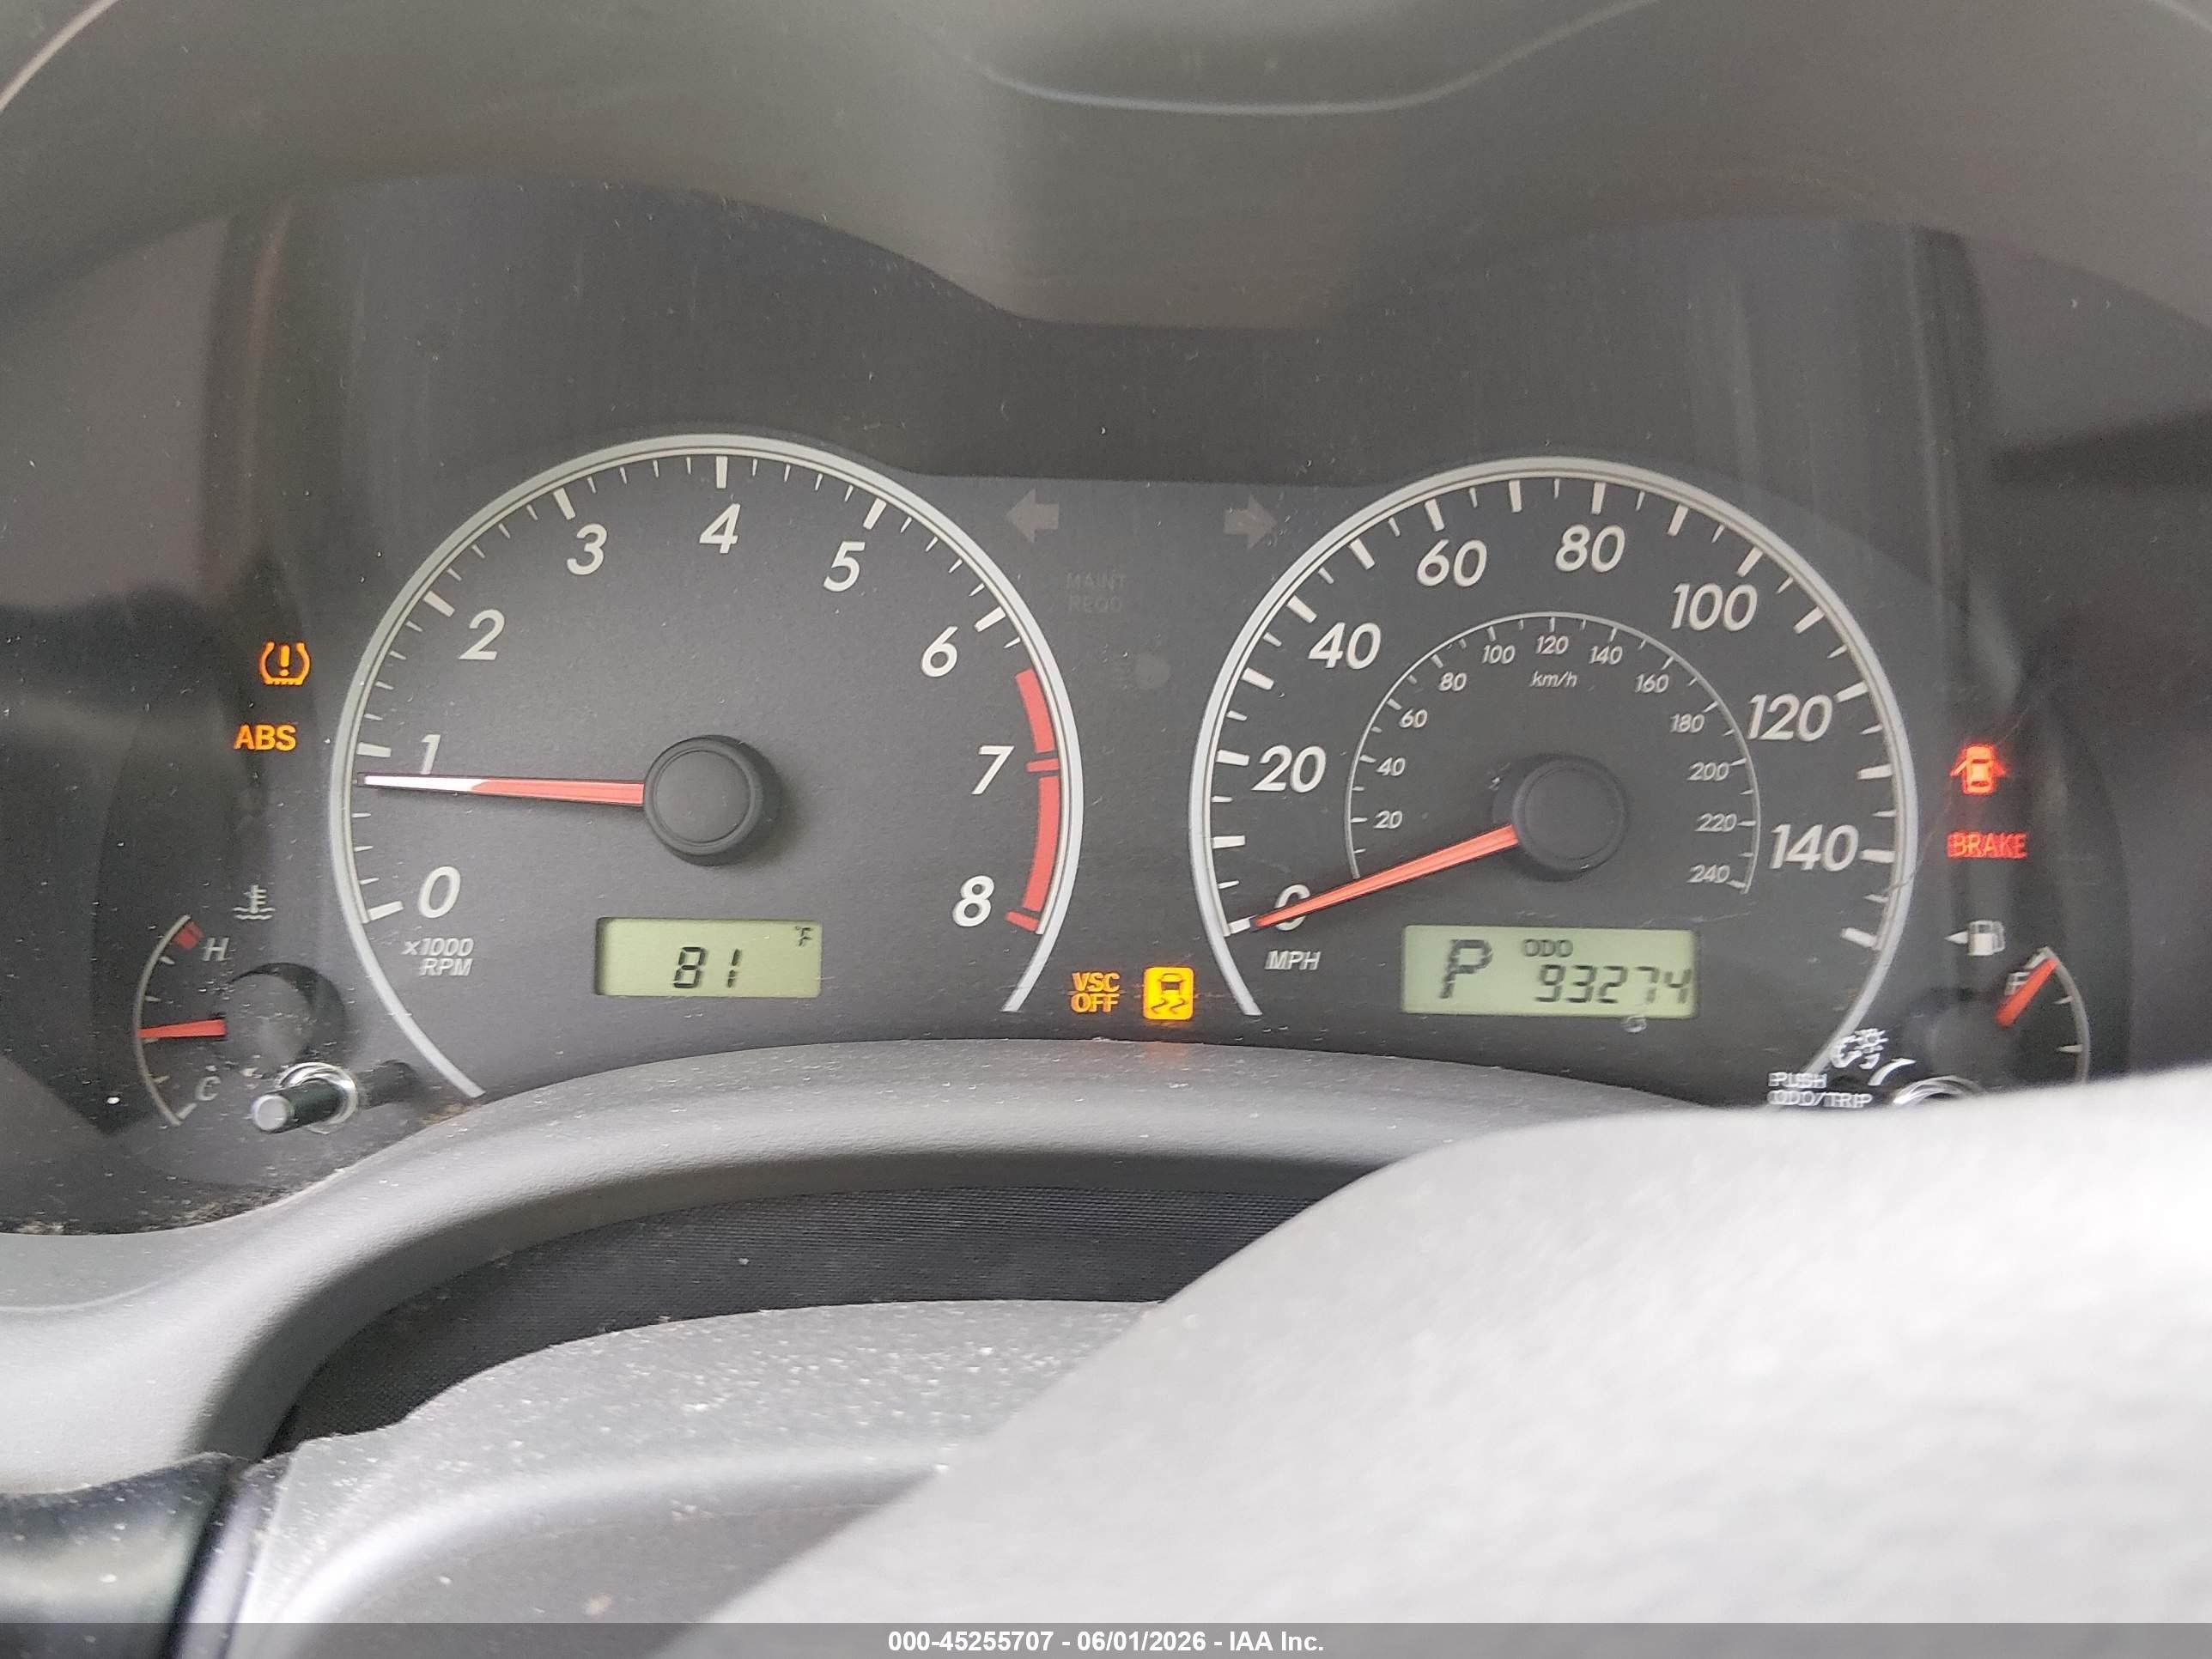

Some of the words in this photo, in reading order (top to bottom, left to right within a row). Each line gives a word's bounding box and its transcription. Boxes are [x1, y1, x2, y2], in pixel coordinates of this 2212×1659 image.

[699, 503, 740, 554] 4
[566, 523, 607, 575] 3
[1554, 525, 1626, 572] 80
[823, 541, 866, 592] 5
[1416, 539, 1487, 587] 60
[1670, 582, 1757, 632] 100
[459, 610, 505, 660] 2
[1308, 622, 1382, 670] 40
[1534, 634, 1570, 656] 120
[921, 626, 958, 678] 6
[1481, 643, 1516, 665] 100
[1589, 644, 1623, 665] 140
[1438, 671, 1467, 691] 80
[1529, 670, 1577, 688] km/h
[1635, 672, 1668, 693] 160
[1400, 709, 1428, 730] 60
[1670, 712, 1705, 733] 180
[1747, 692, 1833, 742] 120
[234, 724, 297, 751] ABS
[417, 734, 441, 775] 1
[971, 744, 1015, 795] 7
[1252, 745, 1327, 793] 20
[1376, 757, 1406, 777] 40
[1688, 761, 1729, 781] 200
[1375, 810, 1403, 830] 20
[1696, 813, 1737, 834] 220
[1770, 824, 1859, 872] 140
[1946, 832, 2028, 860] BRAKE
[1688, 864, 1729, 885] 240
[418, 866, 461, 918] 0
[952, 876, 993, 927] 8
[204, 938, 228, 961] H
[403, 937, 474, 957] x1000
[1522, 938, 1572, 958] ODO
[418, 957, 474, 976] RPM
[672, 947, 742, 988] 81
[1266, 950, 1319, 970] MPH
[1439, 939, 1492, 1000] P
[1071, 971, 1121, 992] VSC
[1534, 963, 1692, 1003] 93274
[1070, 992, 1121, 1013] OFF
[196, 1077, 221, 1101] C
[1768, 1073, 1828, 1089] PUSH
[1767, 1091, 1873, 1109] ODO/TRIP
